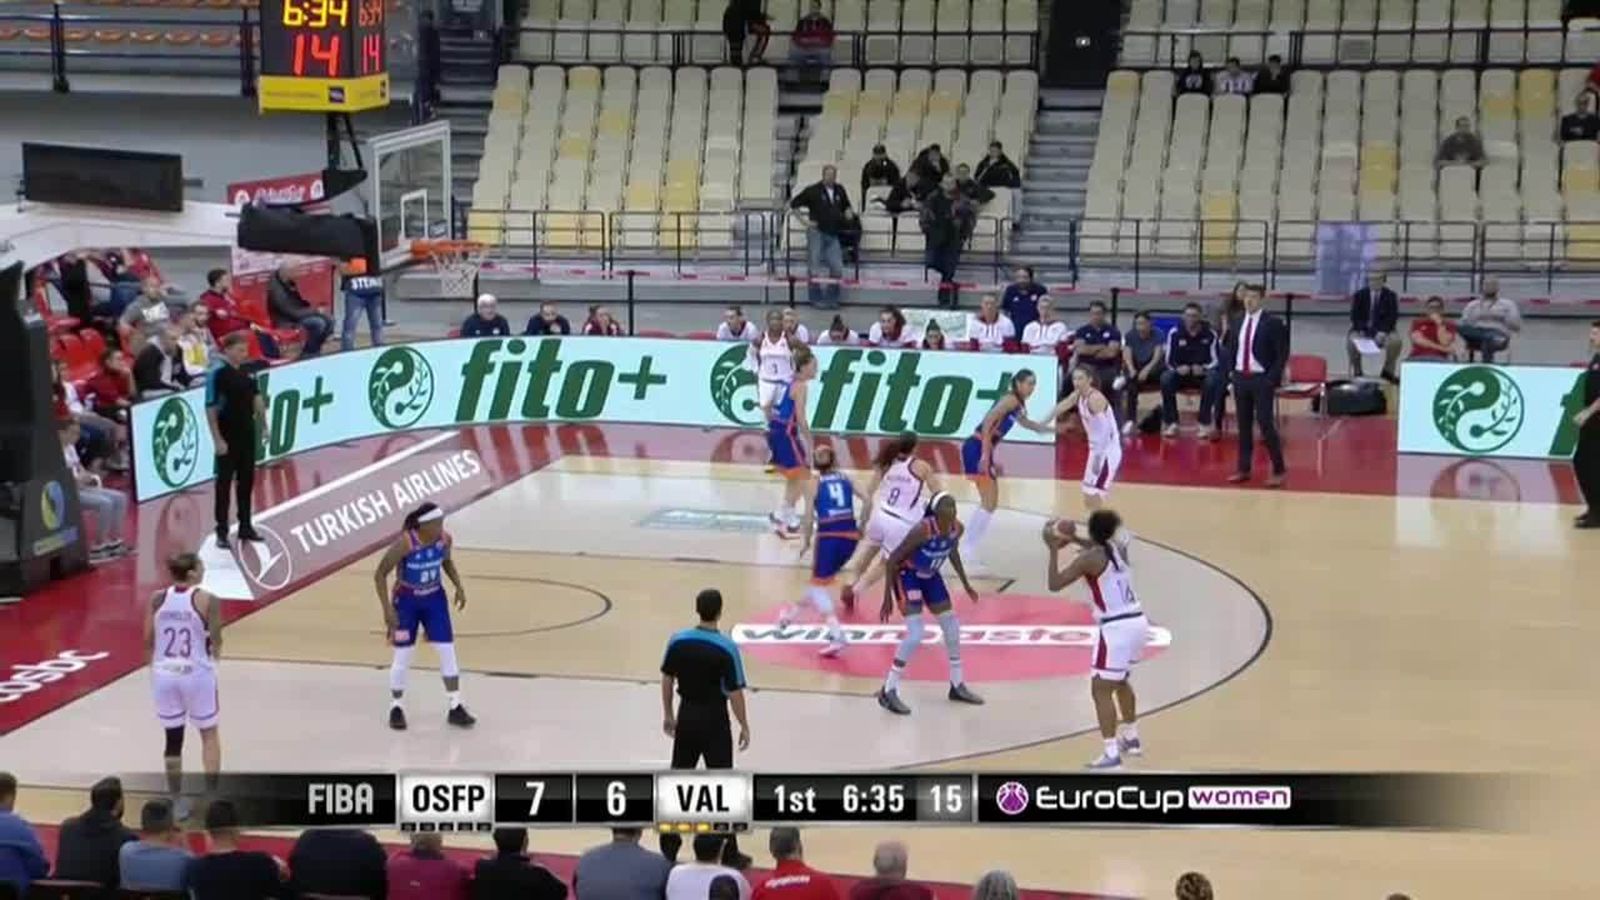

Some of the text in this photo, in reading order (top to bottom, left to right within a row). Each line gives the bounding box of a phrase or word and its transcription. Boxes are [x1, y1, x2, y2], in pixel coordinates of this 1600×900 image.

[283, 0, 348, 26] 6:34
[293, 33, 340, 77] 14
[363, 33, 381, 75] 14
[455, 338, 667, 422] fito+
[290, 449, 481, 554] TURKISH AIRLINES
[827, 482, 845, 507] 4
[163, 626, 192, 658] 23
